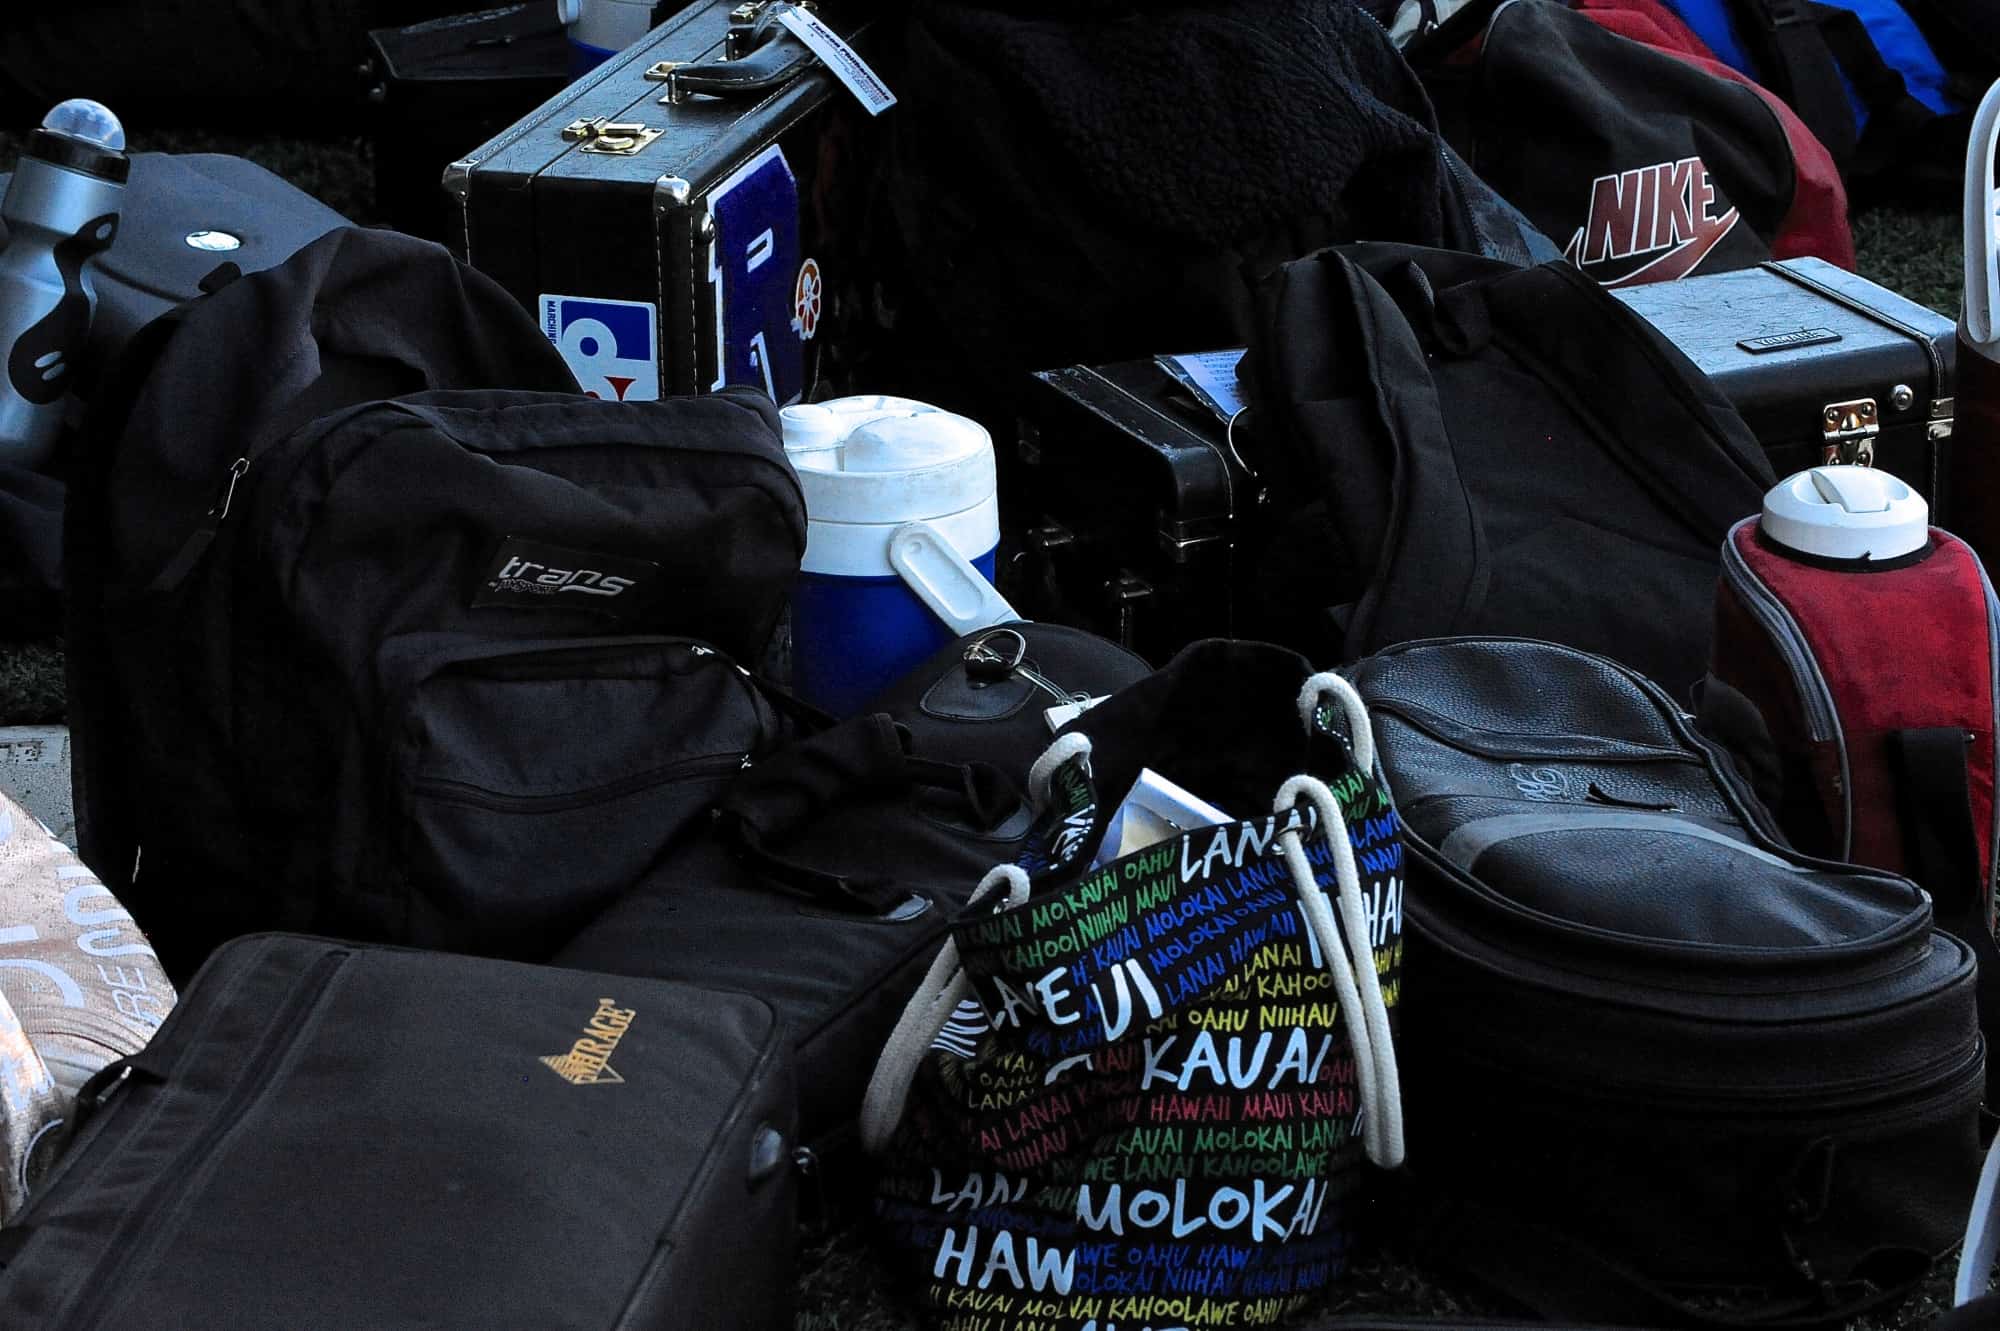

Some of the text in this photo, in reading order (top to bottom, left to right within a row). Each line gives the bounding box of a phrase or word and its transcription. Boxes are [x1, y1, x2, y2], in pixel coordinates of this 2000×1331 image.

[1581, 156, 1717, 264] NIKE
[498, 555, 638, 597] trans
[1124, 844, 1179, 881] OAHU
[1143, 883, 1229, 945] MOLOKAI
[1163, 951, 1227, 1006] LANAI
[1243, 943, 1303, 984] LANAI
[1187, 1005, 1251, 1033] OAHU
[1258, 1001, 1339, 1032] NIIHAU
[1140, 1026, 1334, 1092] KAUAI
[1149, 1092, 1232, 1124] HAWAII
[1240, 1091, 1296, 1122] MAUI
[1115, 1124, 1185, 1154] KAUAI
[1192, 1120, 1294, 1153] MOLOKAI
[1202, 1150, 1328, 1178] KAHOOLAWE
[1075, 1177, 1329, 1244] MOLOKAI
[1126, 1242, 1191, 1269] OAHU
[1074, 1264, 1154, 1294] OLOKAI
[946, 1286, 1015, 1314] KAUAI
[1107, 1295, 1241, 1327] KAHOOLAWE
